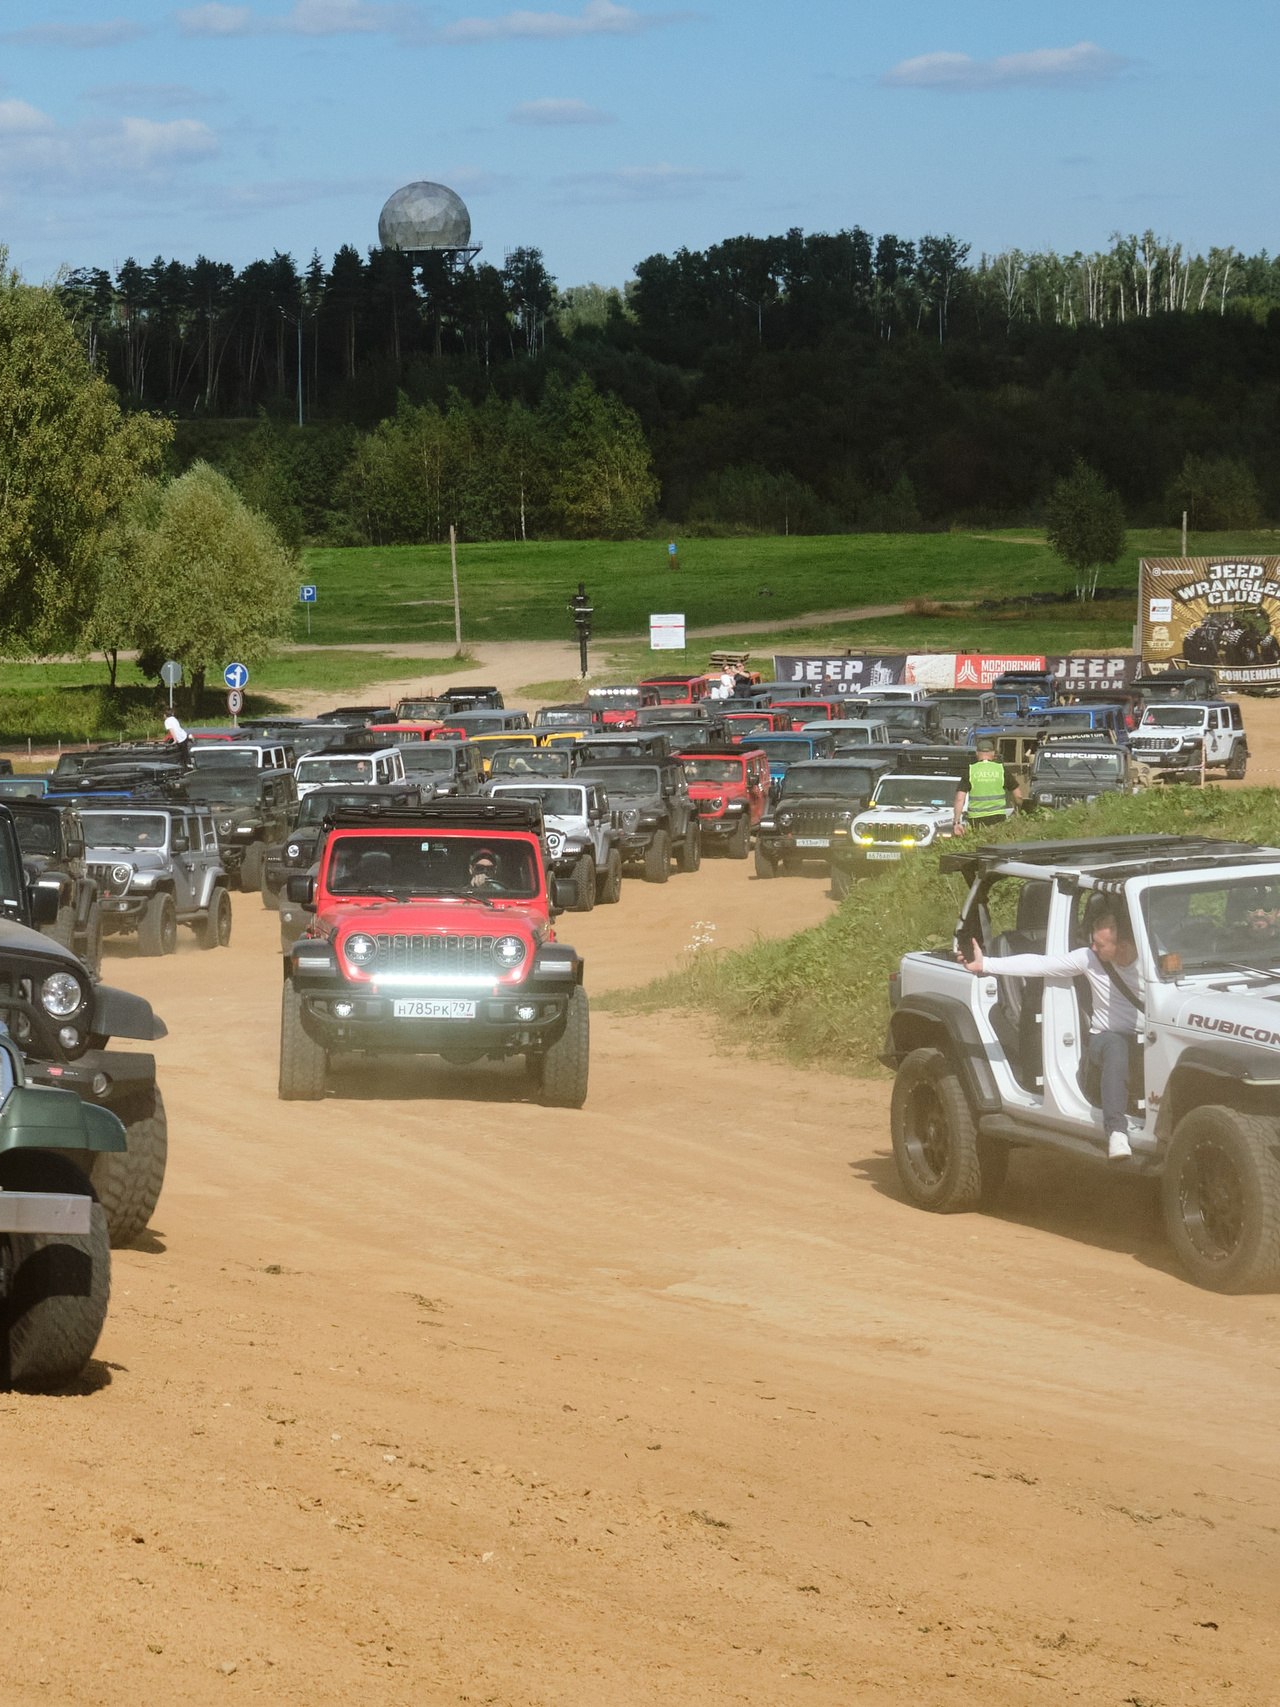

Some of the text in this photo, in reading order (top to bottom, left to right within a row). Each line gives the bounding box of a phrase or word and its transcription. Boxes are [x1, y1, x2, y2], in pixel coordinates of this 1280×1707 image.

[1209, 564, 1263, 579] JEEP
[304, 587, 313, 600] P
[1178, 579, 1280, 600] WRANGLE
[1208, 592, 1261, 604] CLUB
[792, 660, 864, 681] JEEP
[981, 658, 1041, 671] МОСКОВСКИЙ
[1055, 659, 1125, 678] JEEP
[981, 672, 1005, 684] СПО
[1065, 680, 1123, 690] USTOM
[1052, 752, 1117, 760] JEEPCUSTOM
[398, 1001, 472, 1016] Н785РК 797
